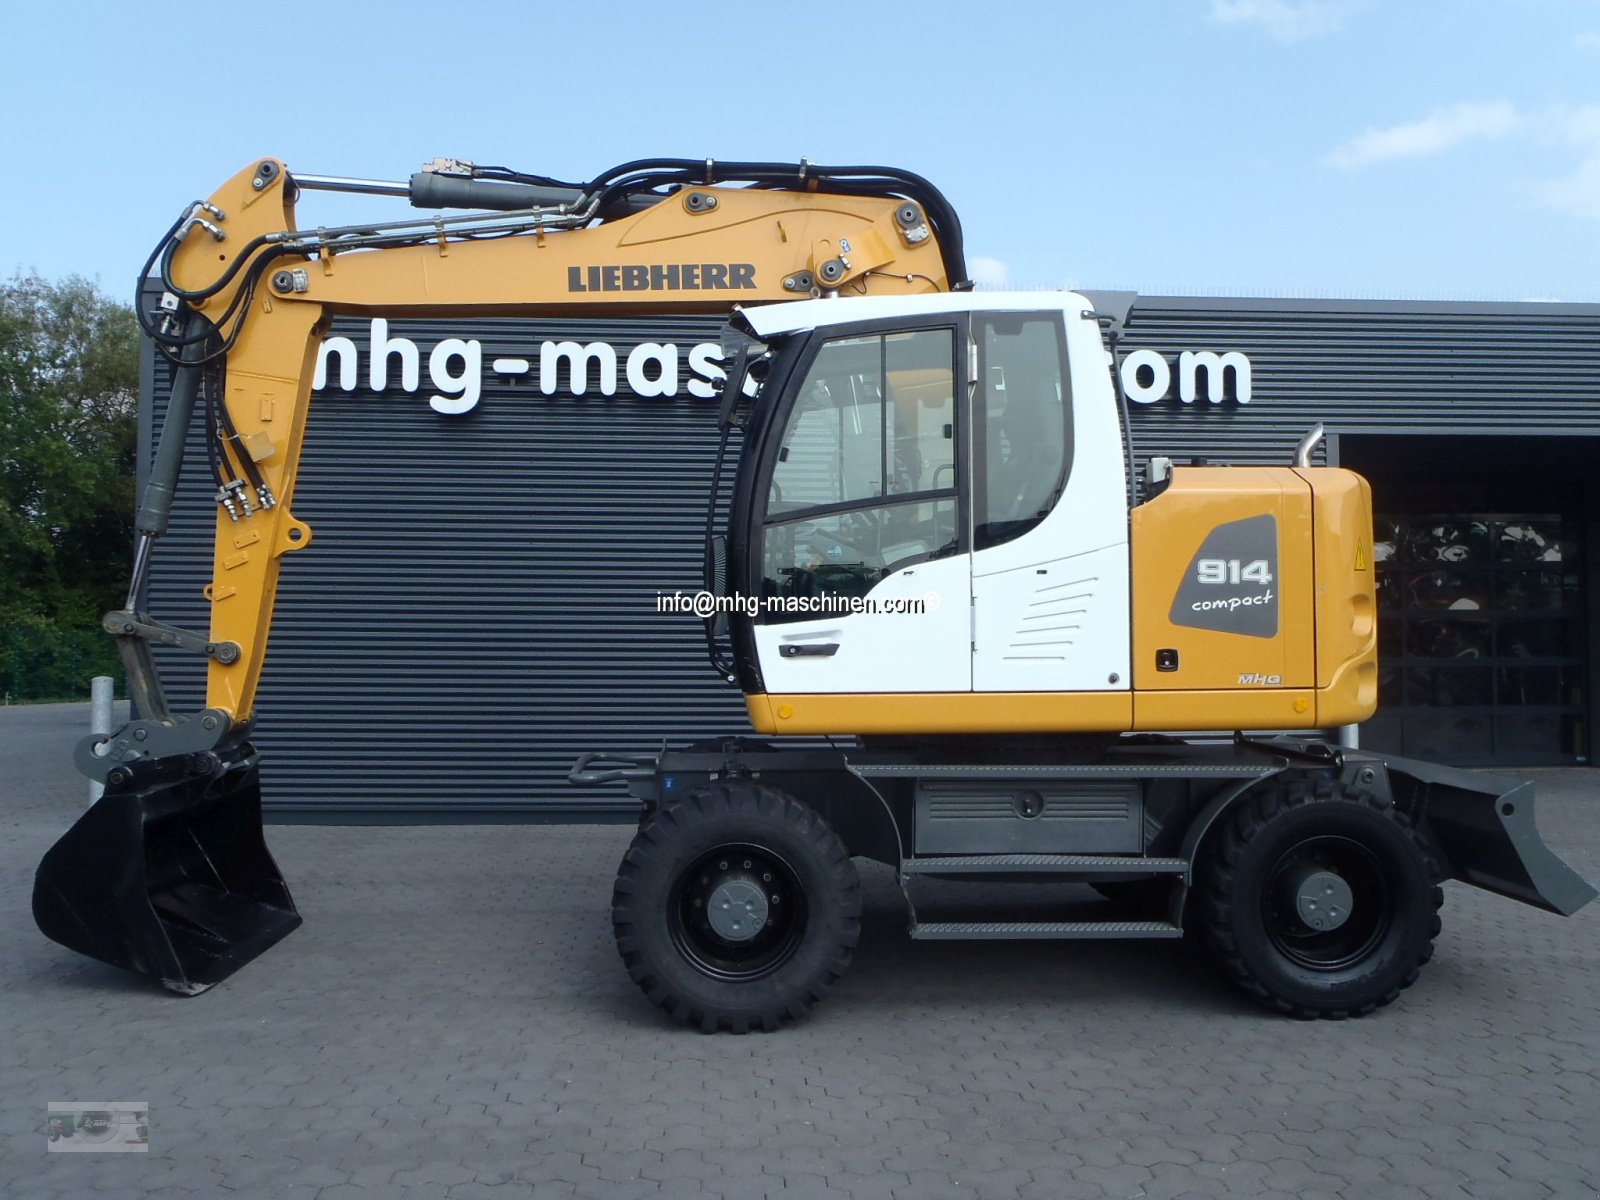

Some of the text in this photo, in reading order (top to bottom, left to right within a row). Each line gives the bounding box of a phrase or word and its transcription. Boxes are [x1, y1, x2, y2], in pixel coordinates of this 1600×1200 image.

[567, 264, 757, 292] LIEBHERR
[1197, 558, 1273, 585] 914
[1191, 589, 1274, 612] compact
[1237, 673, 1282, 686] MHG
